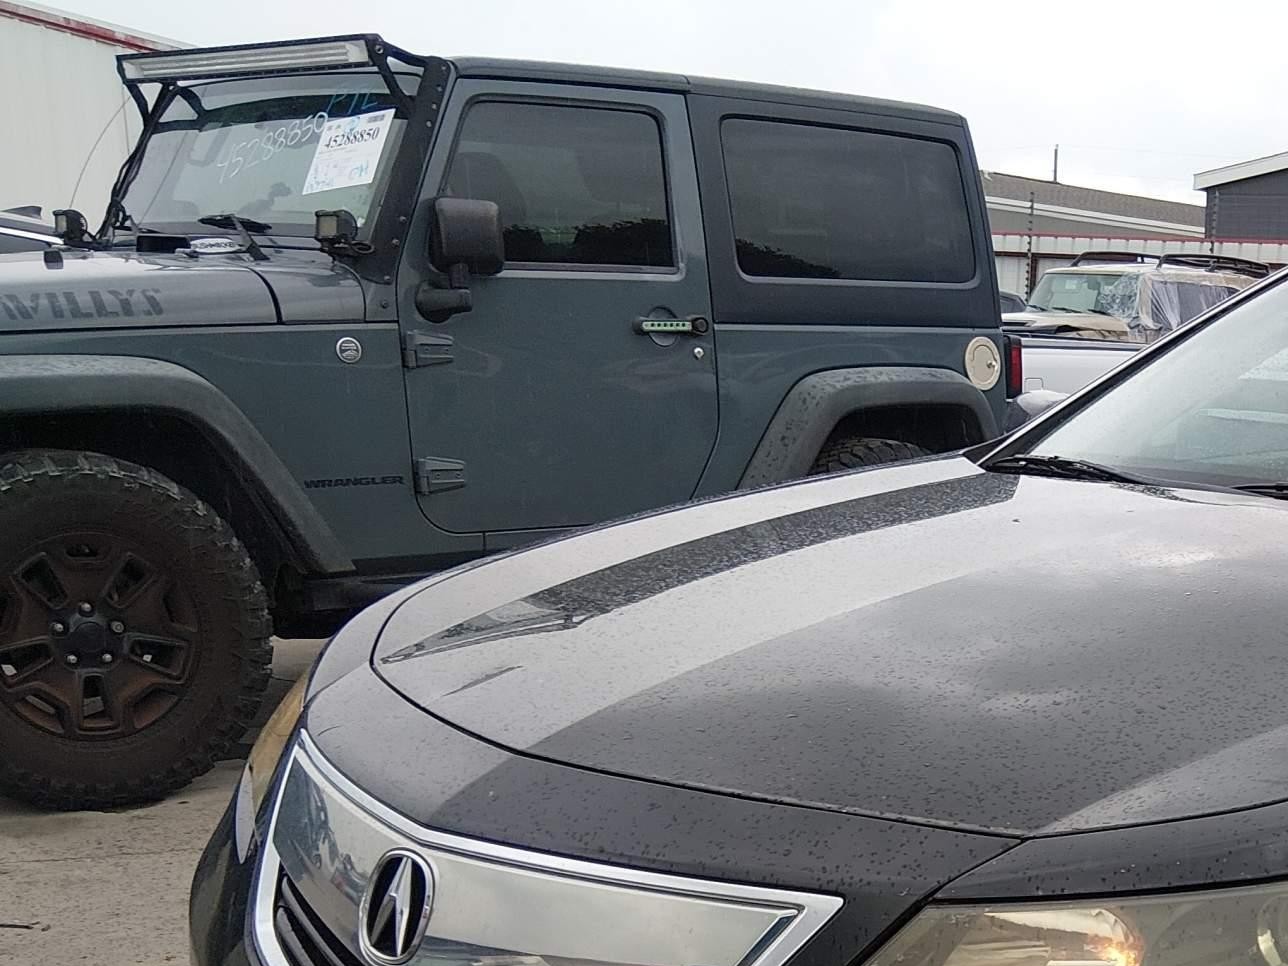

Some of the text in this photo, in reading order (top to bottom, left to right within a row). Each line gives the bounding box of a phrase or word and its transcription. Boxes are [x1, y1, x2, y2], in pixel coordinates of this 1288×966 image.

[216, 112, 328, 184] 45288850
[325, 126, 379, 148] 45288850
[0, 288, 164, 320] WILLYS
[304, 475, 404, 488] WRANGLER
